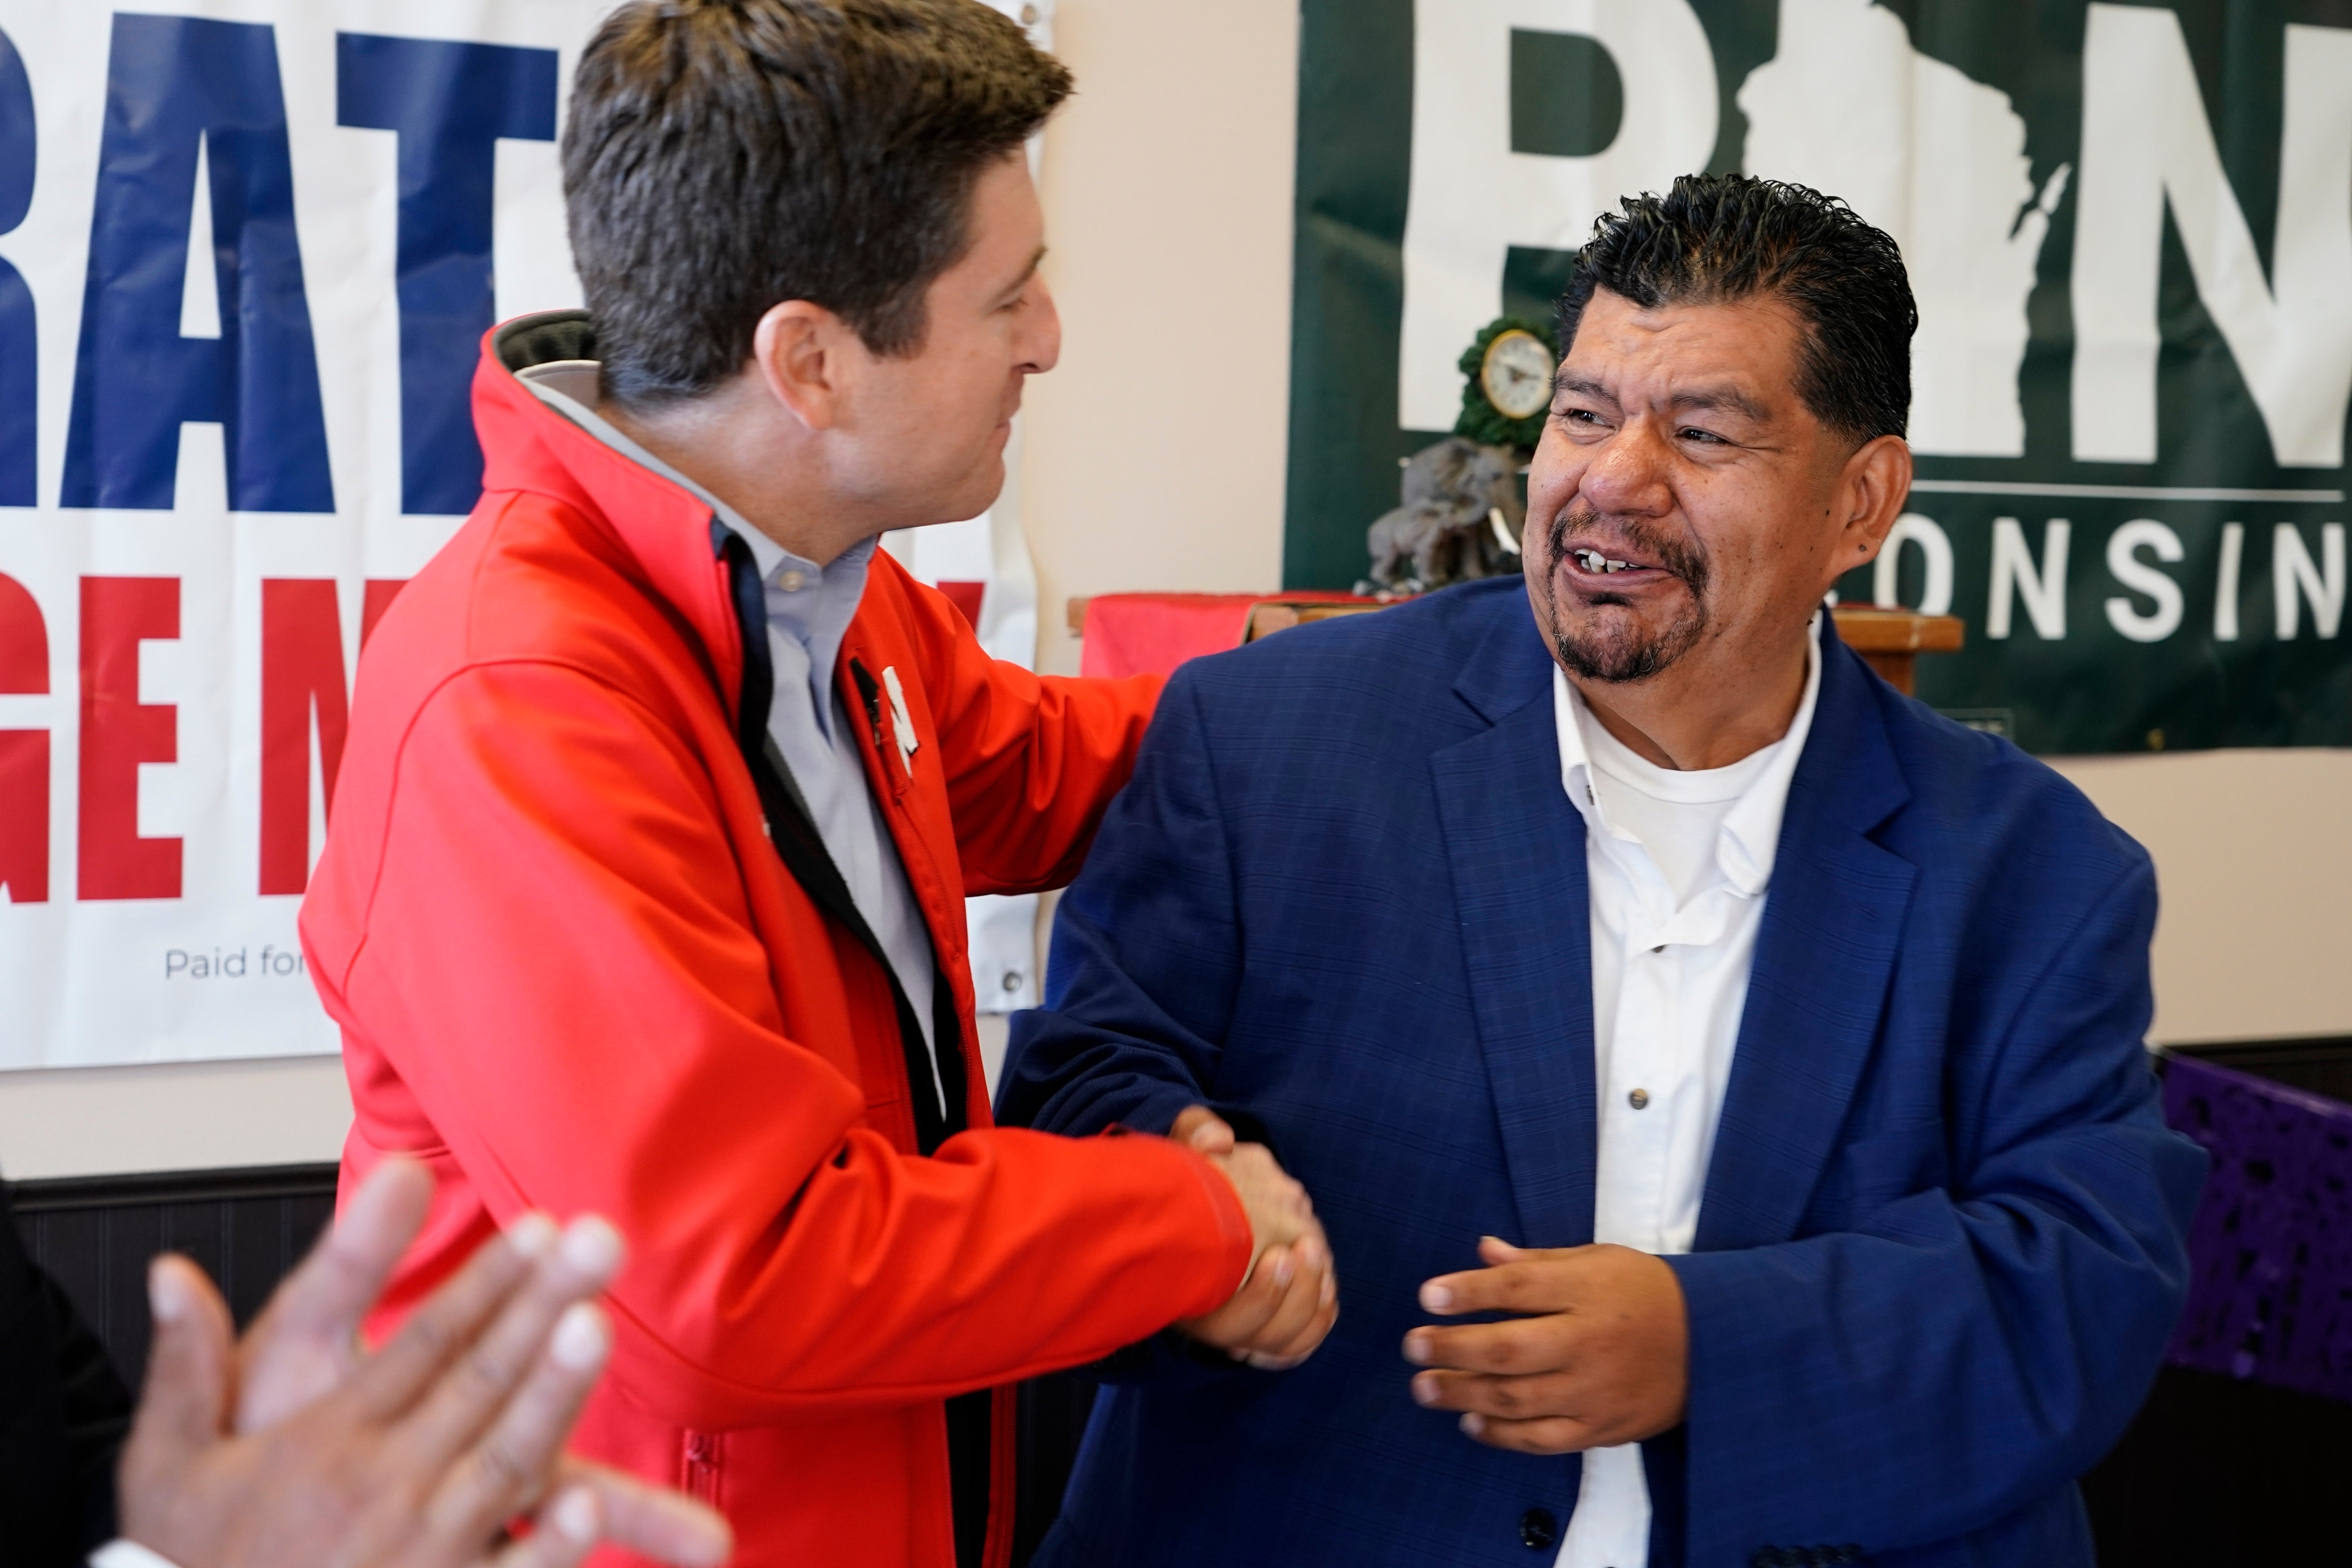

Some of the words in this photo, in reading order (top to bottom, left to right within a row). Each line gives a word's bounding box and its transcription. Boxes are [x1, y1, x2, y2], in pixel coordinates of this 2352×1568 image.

[0, 12, 559, 516] AT
[1824, 512, 2347, 642] ONSIN
[166, 946, 246, 980] Paid
